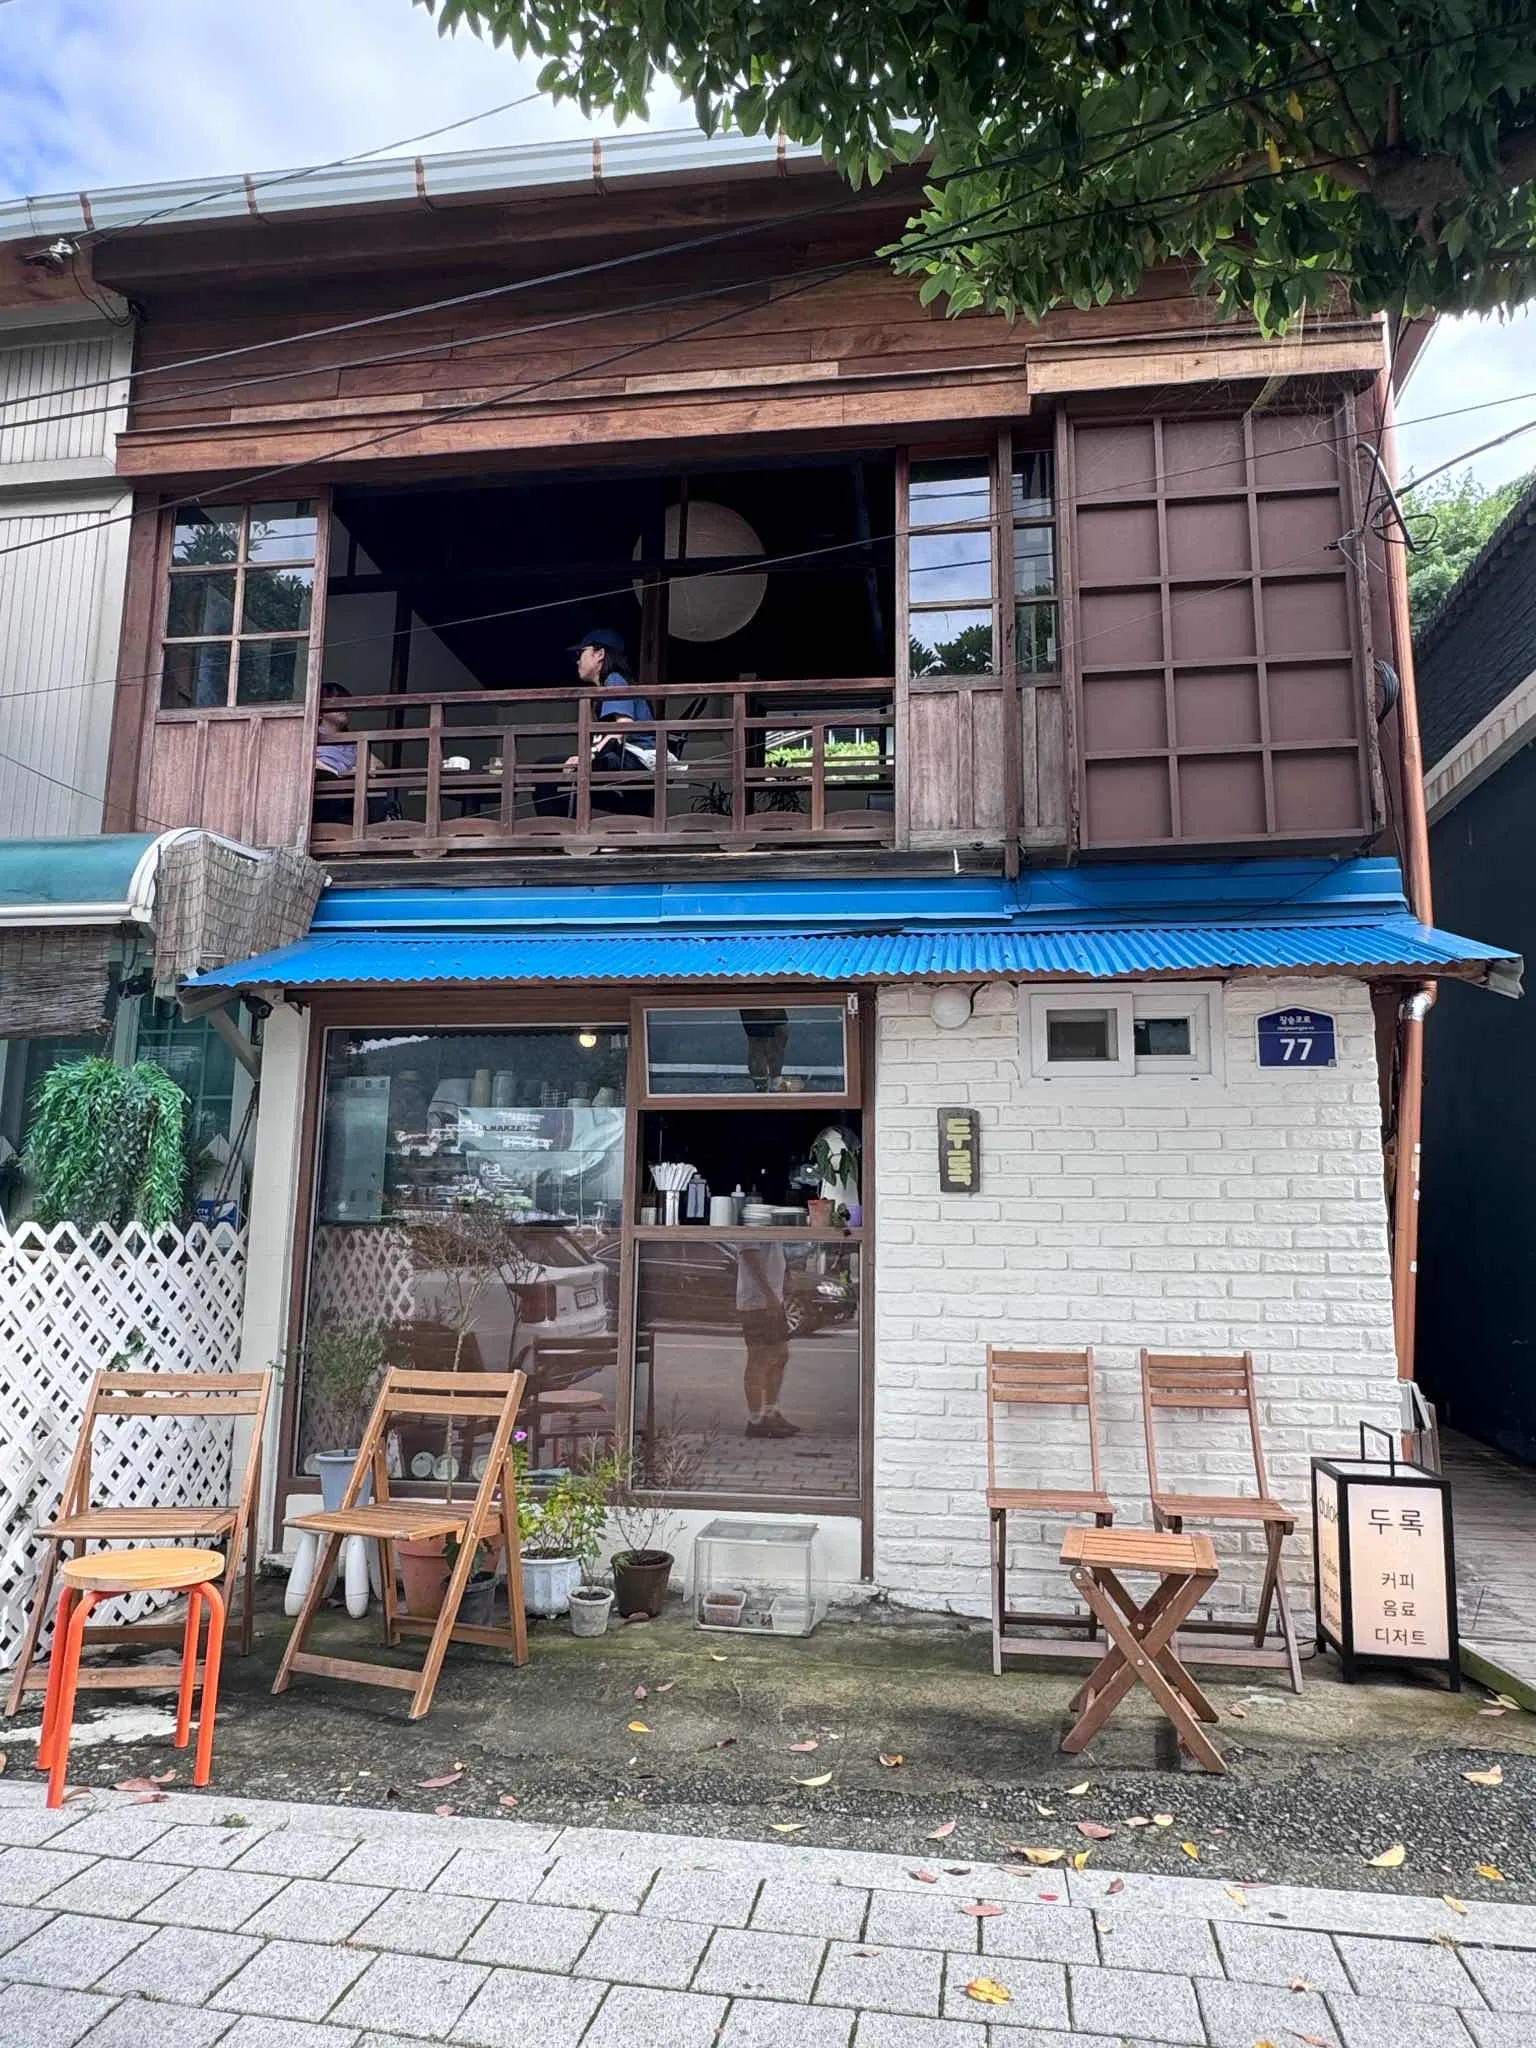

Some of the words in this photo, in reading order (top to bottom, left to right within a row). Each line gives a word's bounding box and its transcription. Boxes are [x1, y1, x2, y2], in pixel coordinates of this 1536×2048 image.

[1280, 1038, 1313, 1061] 77
[946, 1118, 972, 1186] 두록
[1368, 1508, 1424, 1537] 두록
[1381, 1572, 1415, 1590] 커피
[1383, 1599, 1416, 1617] 음료
[1375, 1627, 1427, 1646] 디저트
